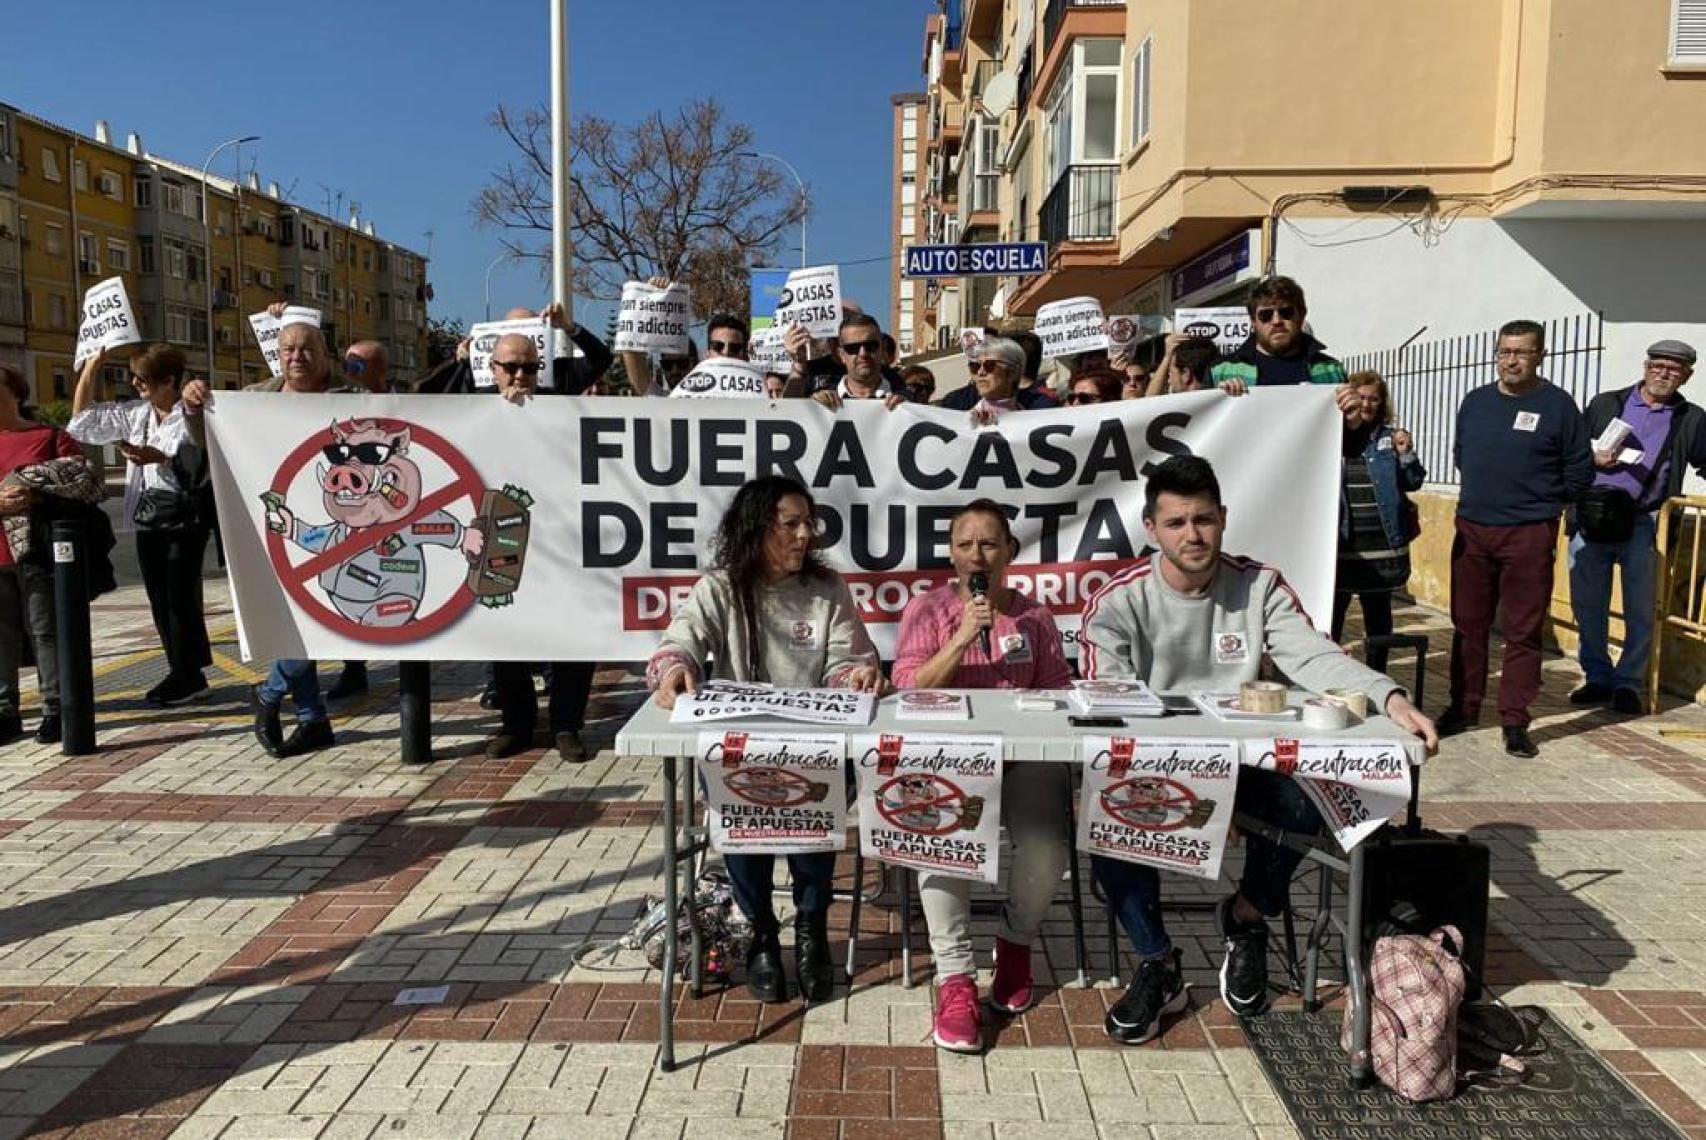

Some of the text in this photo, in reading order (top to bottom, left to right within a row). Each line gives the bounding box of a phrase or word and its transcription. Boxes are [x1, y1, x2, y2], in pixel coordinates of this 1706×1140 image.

[909, 247, 1044, 273] AUTOESCUELA
[796, 283, 834, 303] CASAS
[88, 294, 123, 319] CASAS
[720, 374, 763, 393] CASAS
[579, 416, 875, 487] FUERA
[581, 501, 699, 569] DE
[721, 804, 834, 818] FUERA CASAS
[722, 816, 834, 830] DE APUESTAS
[871, 829, 987, 852] FUERA CASAS
[1090, 821, 1211, 850] FUERA CASAS
[1116, 835, 1209, 860] APUESTAS
[897, 842, 986, 863] APUESTAS
